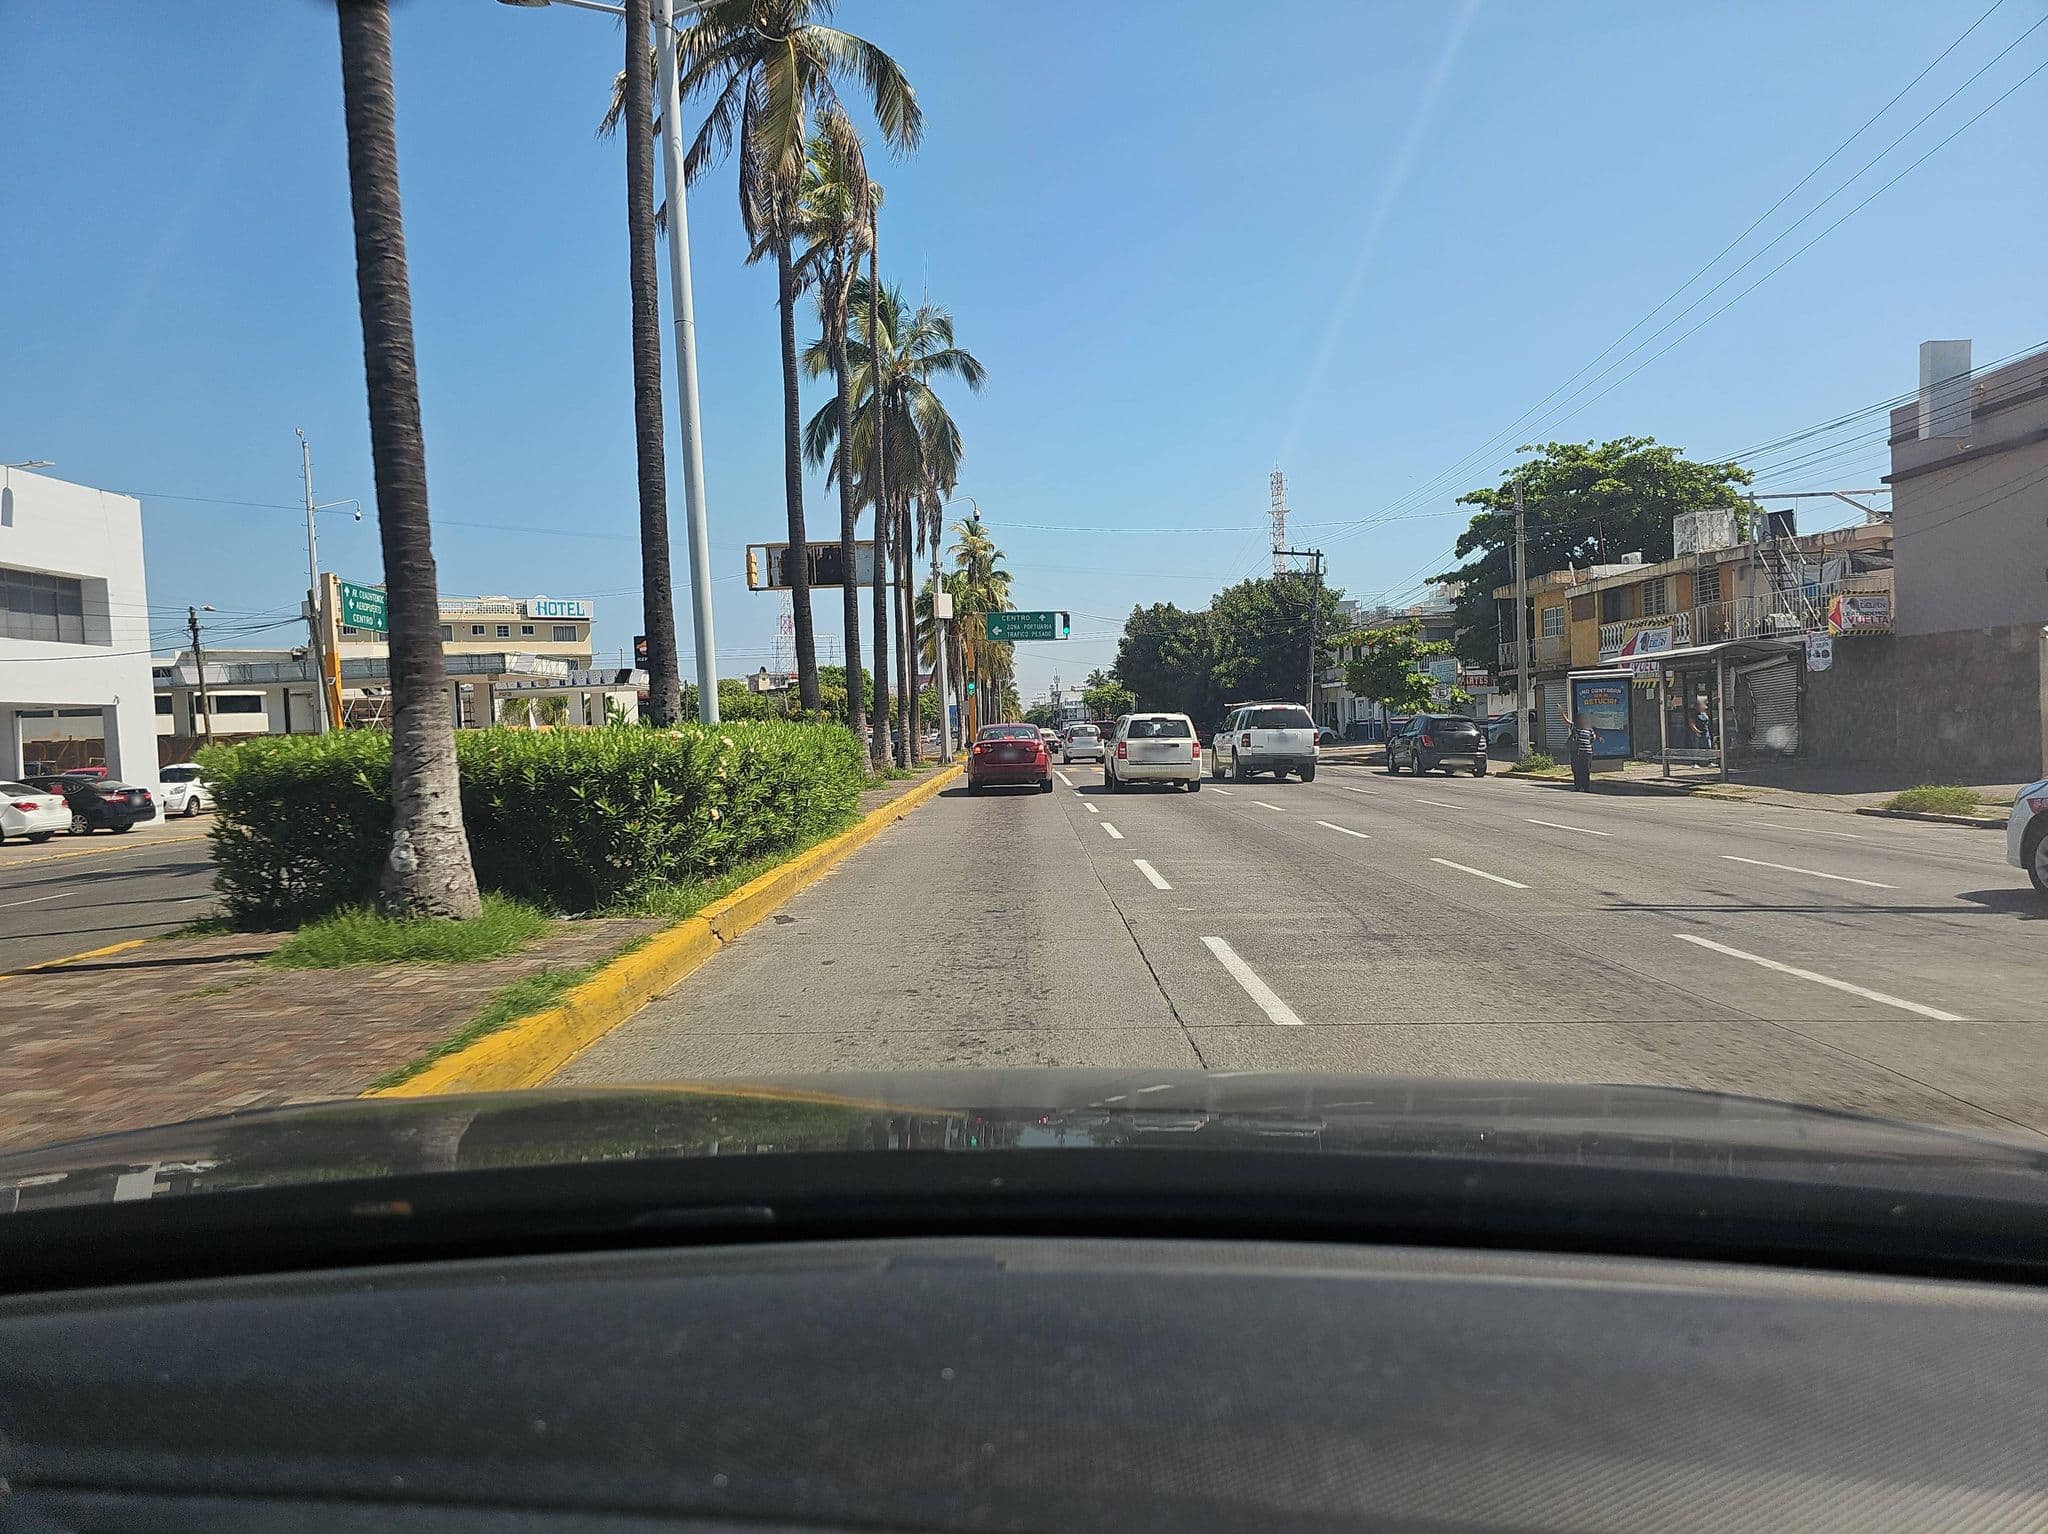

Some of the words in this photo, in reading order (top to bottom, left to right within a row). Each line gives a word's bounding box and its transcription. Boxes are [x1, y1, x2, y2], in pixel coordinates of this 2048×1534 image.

[356, 602, 382, 614] AEROPUERTO
[535, 601, 585, 616] HOTEL
[353, 613, 373, 625] CENTRO
[1632, 662, 1660, 672] VUELT
